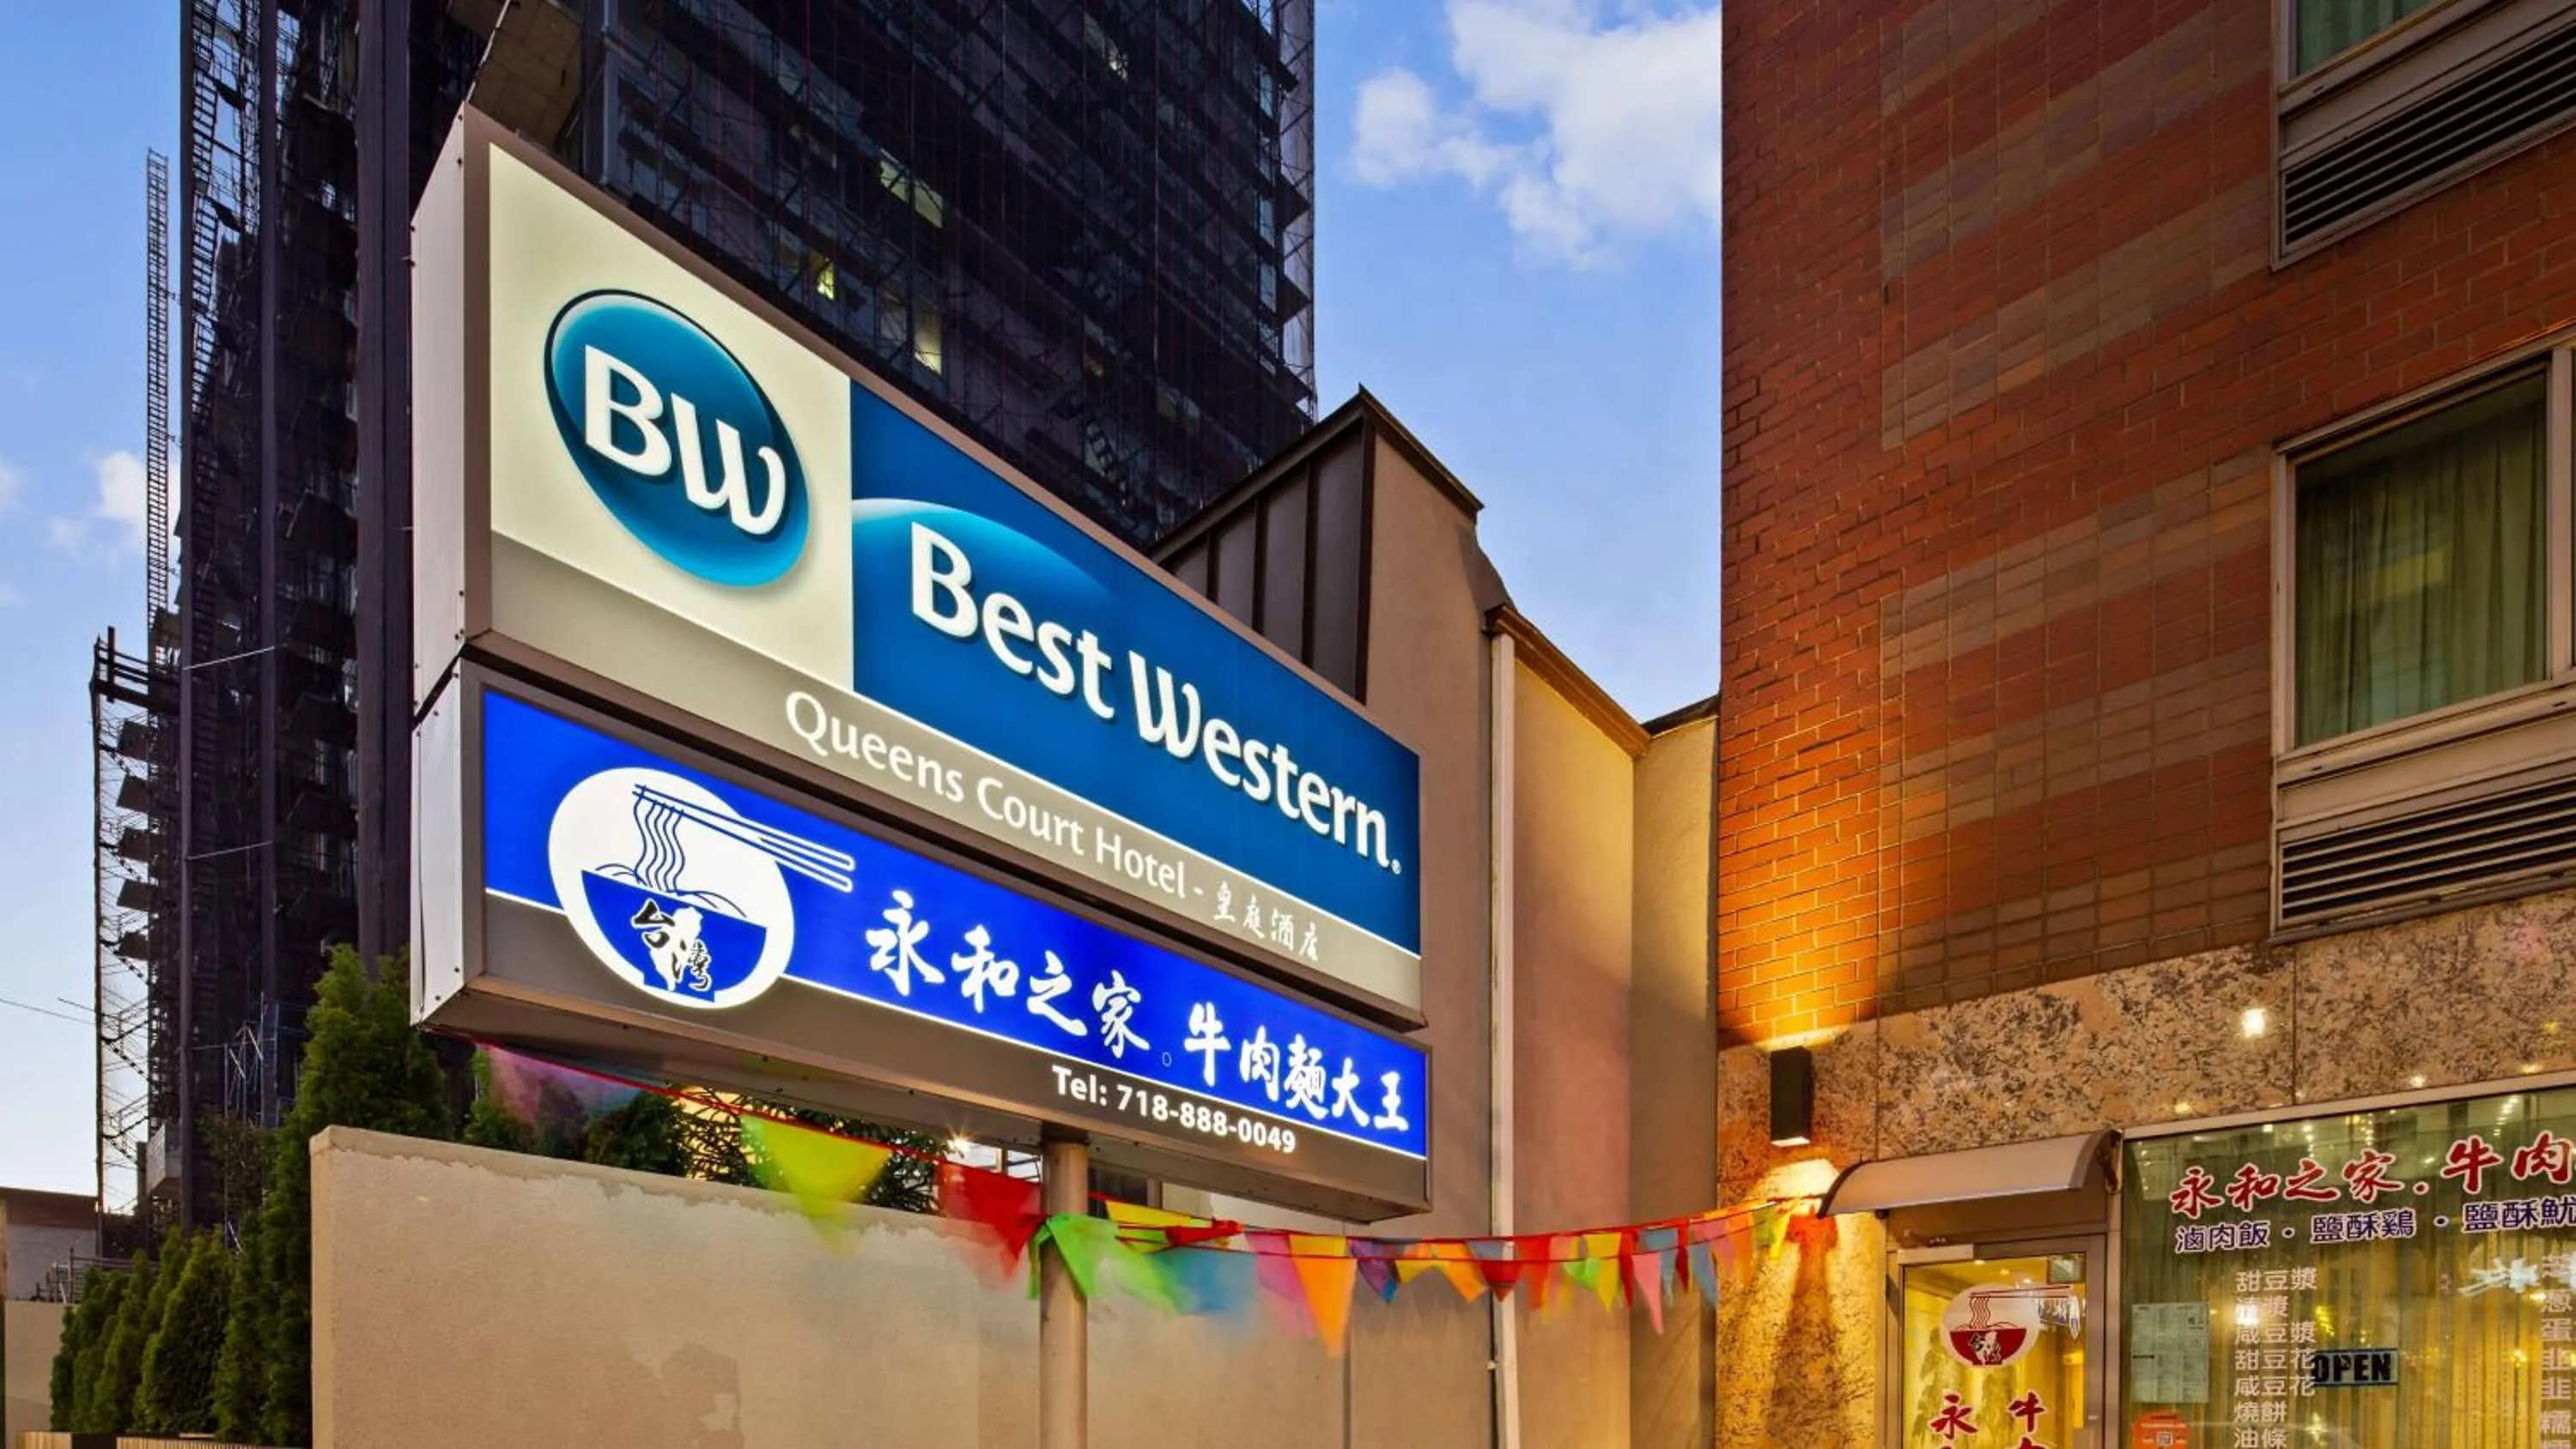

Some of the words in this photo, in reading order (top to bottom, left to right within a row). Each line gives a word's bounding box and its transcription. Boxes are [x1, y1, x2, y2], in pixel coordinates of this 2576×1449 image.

[586, 344, 786, 535] BW
[911, 522, 1114, 719] Best
[785, 691, 964, 803] Queens
[976, 777, 1084, 856] Court
[1096, 826, 1186, 899] Hotel
[1213, 880, 1319, 962] 皇庭酒店
[866, 889, 1150, 1058] 永和之家
[1052, 1065, 1107, 1106] Tel:
[1116, 1084, 1297, 1154] 718-888-0049
[2313, 1352, 2392, 1382] OPEN
[2542, 1319, 2576, 1342] 蛋
